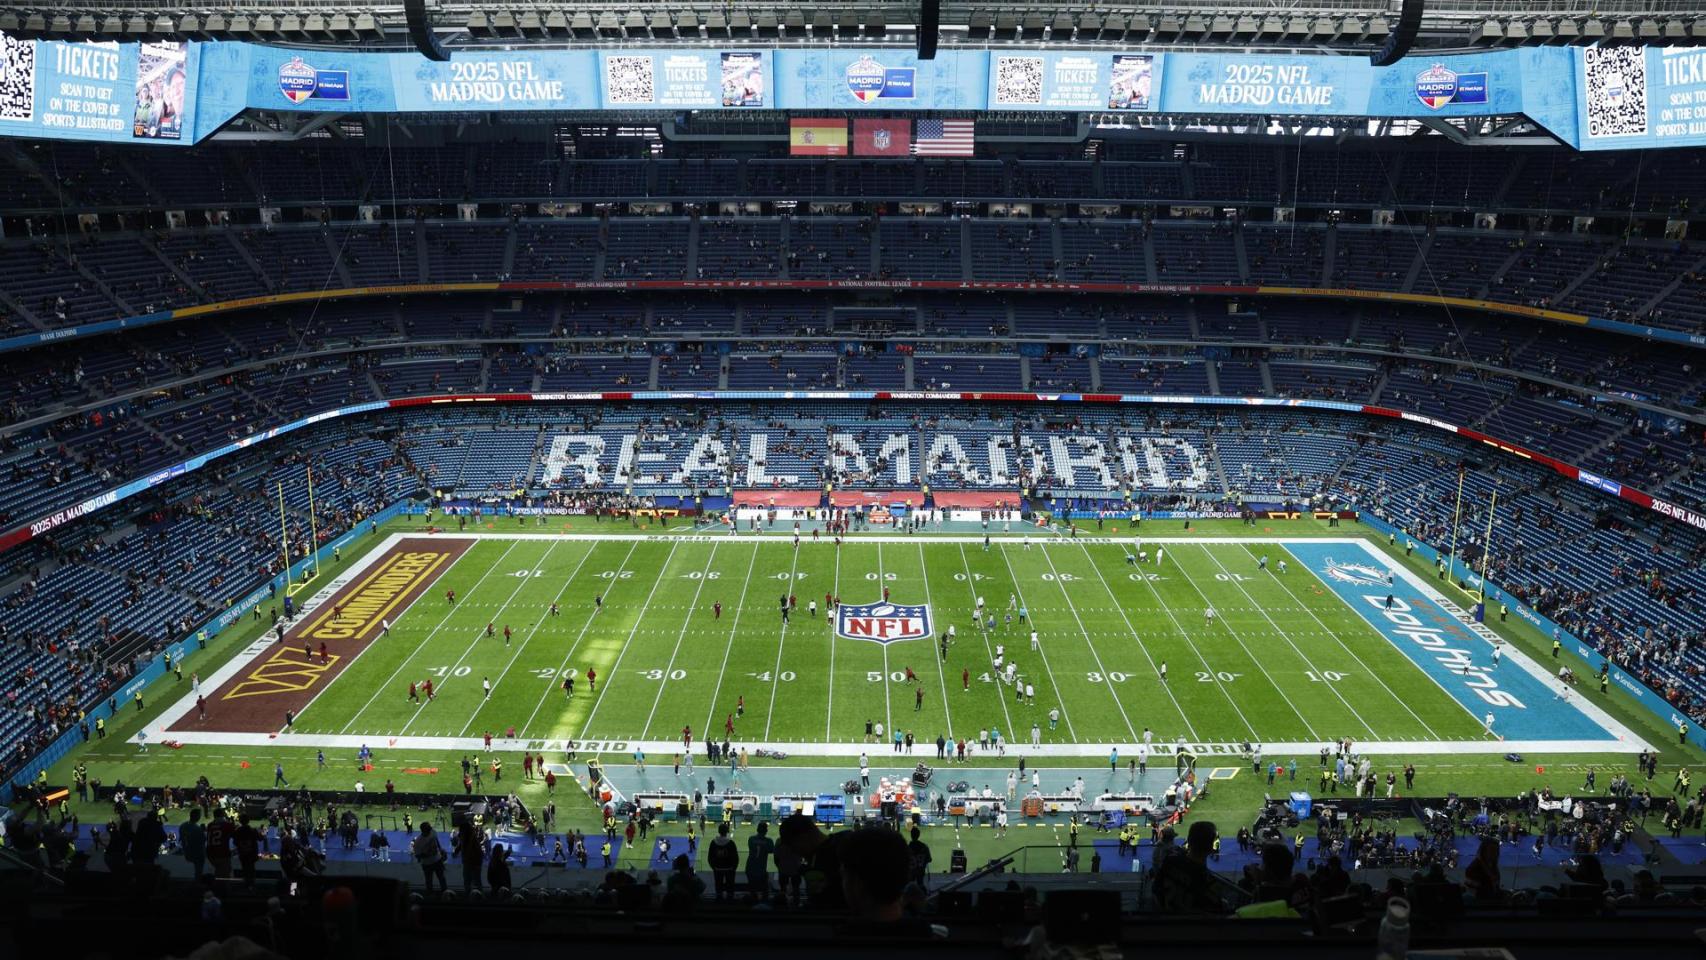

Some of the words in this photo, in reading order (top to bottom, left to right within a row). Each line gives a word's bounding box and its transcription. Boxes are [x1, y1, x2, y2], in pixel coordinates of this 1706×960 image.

[56, 44, 119, 80] TICKETS
[450, 62, 500, 80] 2025
[502, 62, 538, 80] NFL
[665, 68, 707, 81] TICKETS
[1055, 70, 1098, 83] TICKETS
[1225, 64, 1274, 84] 2025
[1276, 65, 1312, 85] NFL
[849, 77, 881, 85] MADRID
[60, 82, 82, 97] SCAN
[84, 85, 96, 99] TO
[97, 87, 112, 100] GET
[431, 81, 505, 102] MADRID
[508, 81, 564, 100] GAME
[1200, 84, 1274, 105] MADRID
[1277, 85, 1333, 105] GAME
[1670, 91, 1692, 106] SCAN
[50, 98, 62, 111] ON
[65, 100, 80, 112] THE
[82, 102, 109, 114] COVER
[110, 104, 120, 115] OF
[1661, 109, 1673, 122] ON
[1675, 108, 1692, 121] THE
[43, 113, 75, 129] SPORTS
[76, 116, 125, 131] ILLUSTRATED
[1656, 123, 1687, 137] SPORTS
[541, 433, 800, 485] REAL
[831, 432, 1210, 487] MADRID
[150, 471, 169, 482] MADRID
[531, 506, 543, 515] NFL
[544, 506, 567, 515] MADRID
[568, 506, 586, 515] GAME
[1171, 511, 1186, 519] 2025
[1187, 511, 1198, 519] NFL
[1200, 511, 1223, 519] MADRID
[1224, 511, 1242, 519] GAME
[1652, 498, 1672, 515] 2025
[1670, 507, 1687, 522] NFL
[31, 518, 51, 537] 2025
[51, 510, 67, 528] NFL
[67, 499, 96, 521] MADRID
[689, 571, 721, 579] 30
[777, 572, 809, 580] 40
[865, 573, 897, 581] 50
[954, 573, 985, 581] 40
[1041, 573, 1074, 581] 30
[1129, 573, 1161, 582] 20
[1215, 573, 1245, 581] 10
[313, 552, 438, 639] COMMANDERS
[1434, 599, 1462, 613] END
[848, 618, 922, 638] NFL
[433, 666, 472, 677] 10
[537, 668, 579, 679] 20
[645, 669, 688, 681] 30
[756, 671, 797, 682] 40
[866, 671, 907, 682] 50
[1087, 671, 1127, 683] 30
[1194, 671, 1235, 683] 20
[1304, 670, 1343, 682] 10
[526, 741, 629, 752] MADRID
